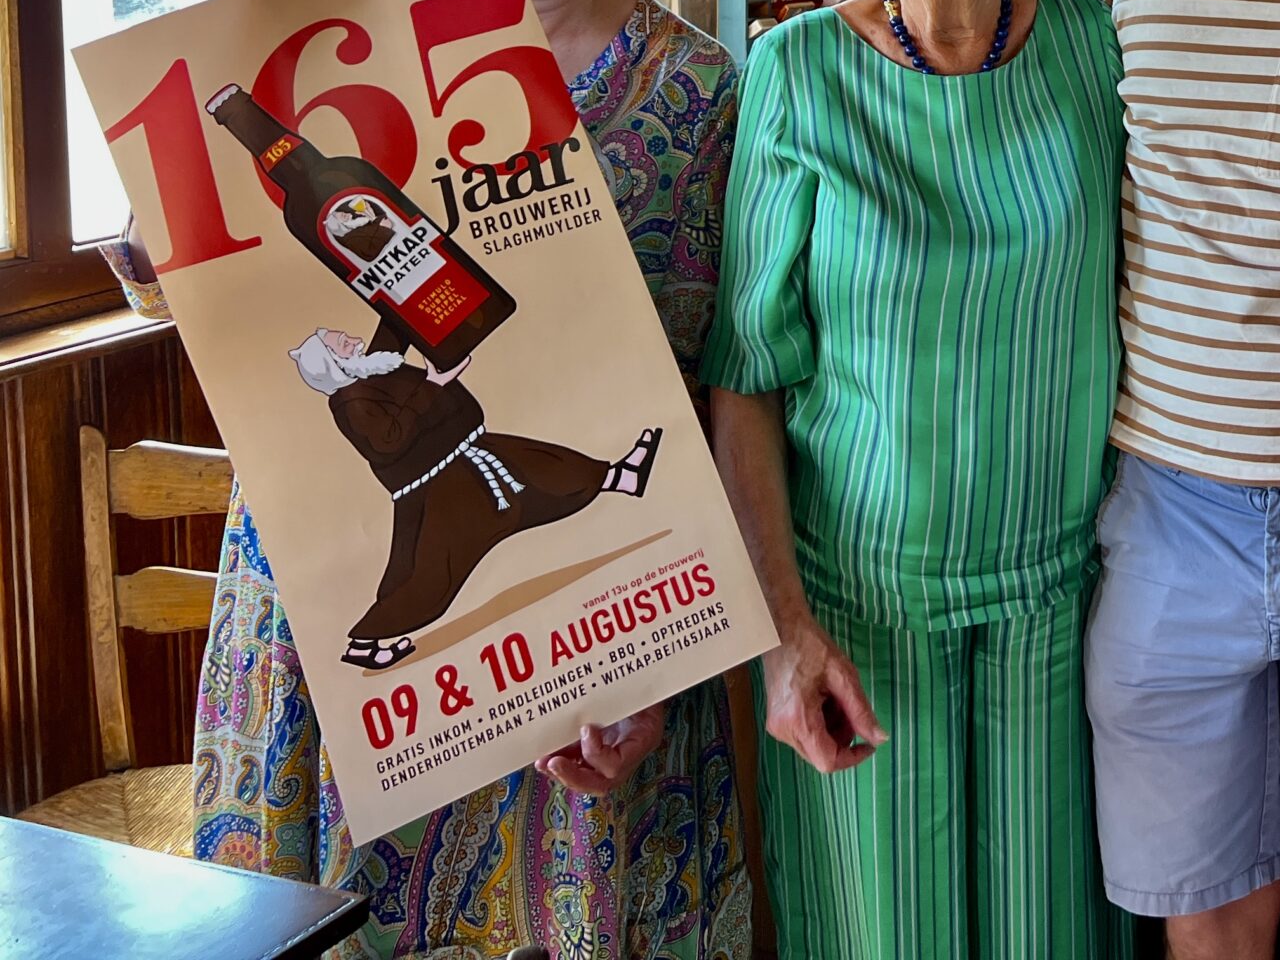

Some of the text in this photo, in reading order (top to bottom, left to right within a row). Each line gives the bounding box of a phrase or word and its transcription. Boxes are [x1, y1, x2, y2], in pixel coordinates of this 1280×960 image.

[265, 139, 292, 163] 165
[431, 137, 581, 237] jaar
[469, 187, 592, 240] BROUWERIJ
[483, 208, 602, 255] SLAGHMUYLDER
[356, 226, 428, 292] WITKAP
[383, 247, 432, 291] PATER
[417, 279, 452, 310] STIMULO
[424, 286, 456, 314] DUBBEL
[431, 292, 460, 318] TRIPEL
[434, 295, 468, 325] SPECIAL
[582, 547, 705, 610] vanaf 13u op de brouwerij
[361, 562, 716, 750] 09 & 10 AUGUSTUS
[376, 601, 725, 775] GRATIS INKOM RONDLEIDINGEN BBQ OPTREDENS
[380, 617, 731, 792] DENDERHOUTEMBAAN 2 NINOVE WITKAP.BE/165JAAR
